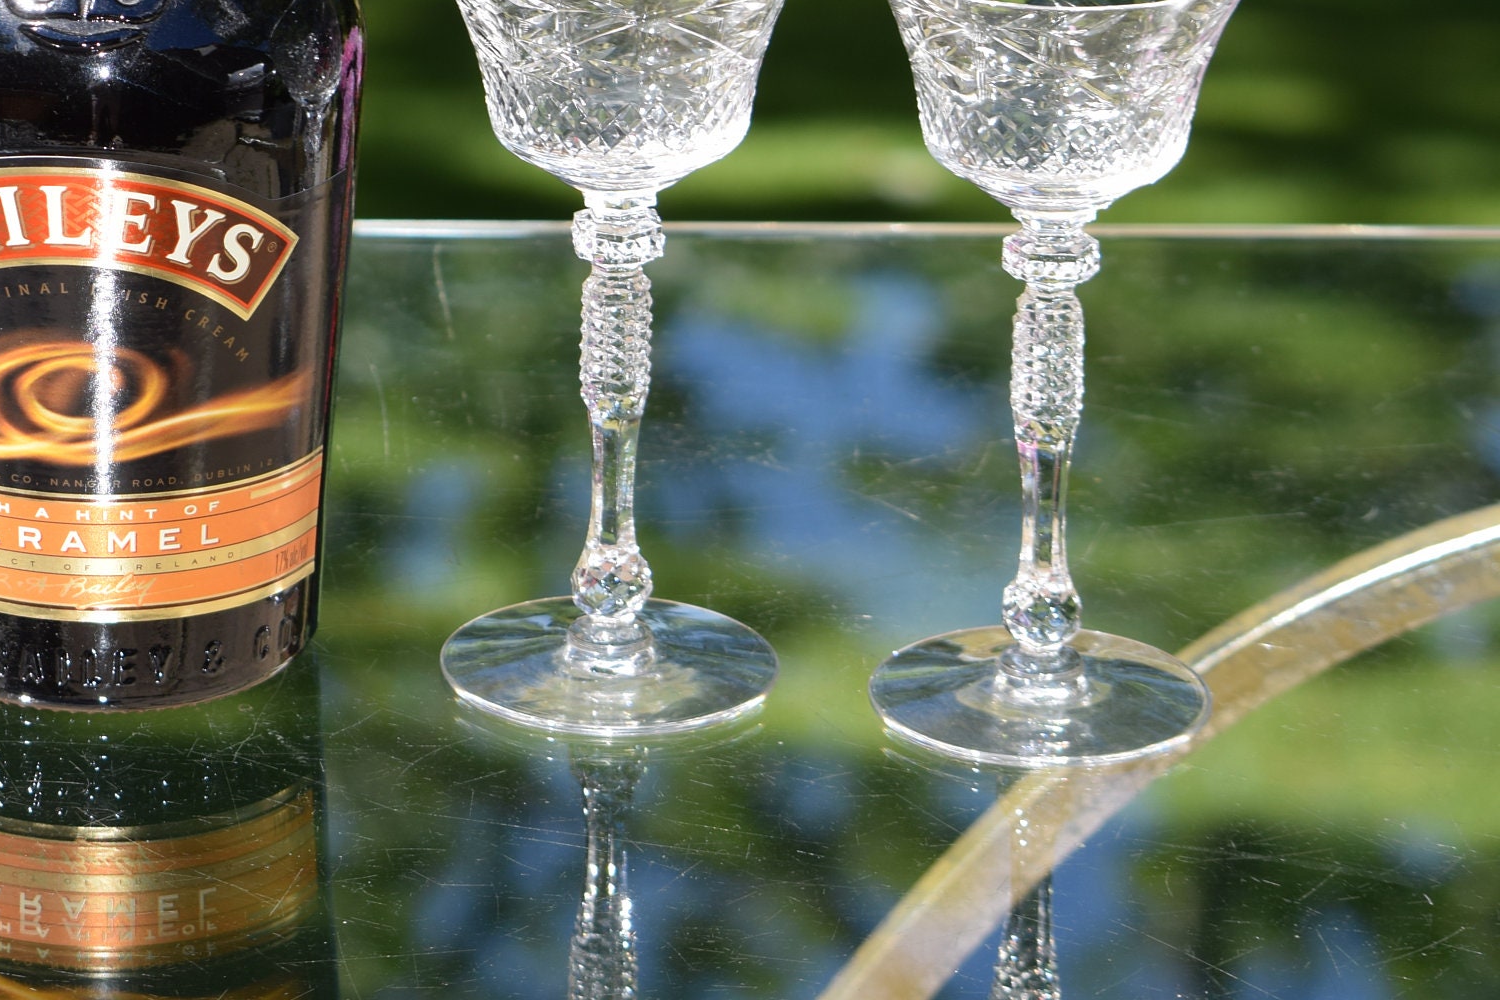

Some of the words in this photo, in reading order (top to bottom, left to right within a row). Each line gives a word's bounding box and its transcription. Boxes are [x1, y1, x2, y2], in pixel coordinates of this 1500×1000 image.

[90, 283, 169, 310] IISH
[184, 308, 250, 363] CREAM
[50, 478, 121, 488] NANGR
[193, 463, 251, 482] DUBLIN
[35, 507, 50, 519] A
[75, 508, 158, 521] HINT
[184, 500, 221, 516] OF
[63, 563, 90, 572] OF
[120, 551, 235, 571] IRELAND
